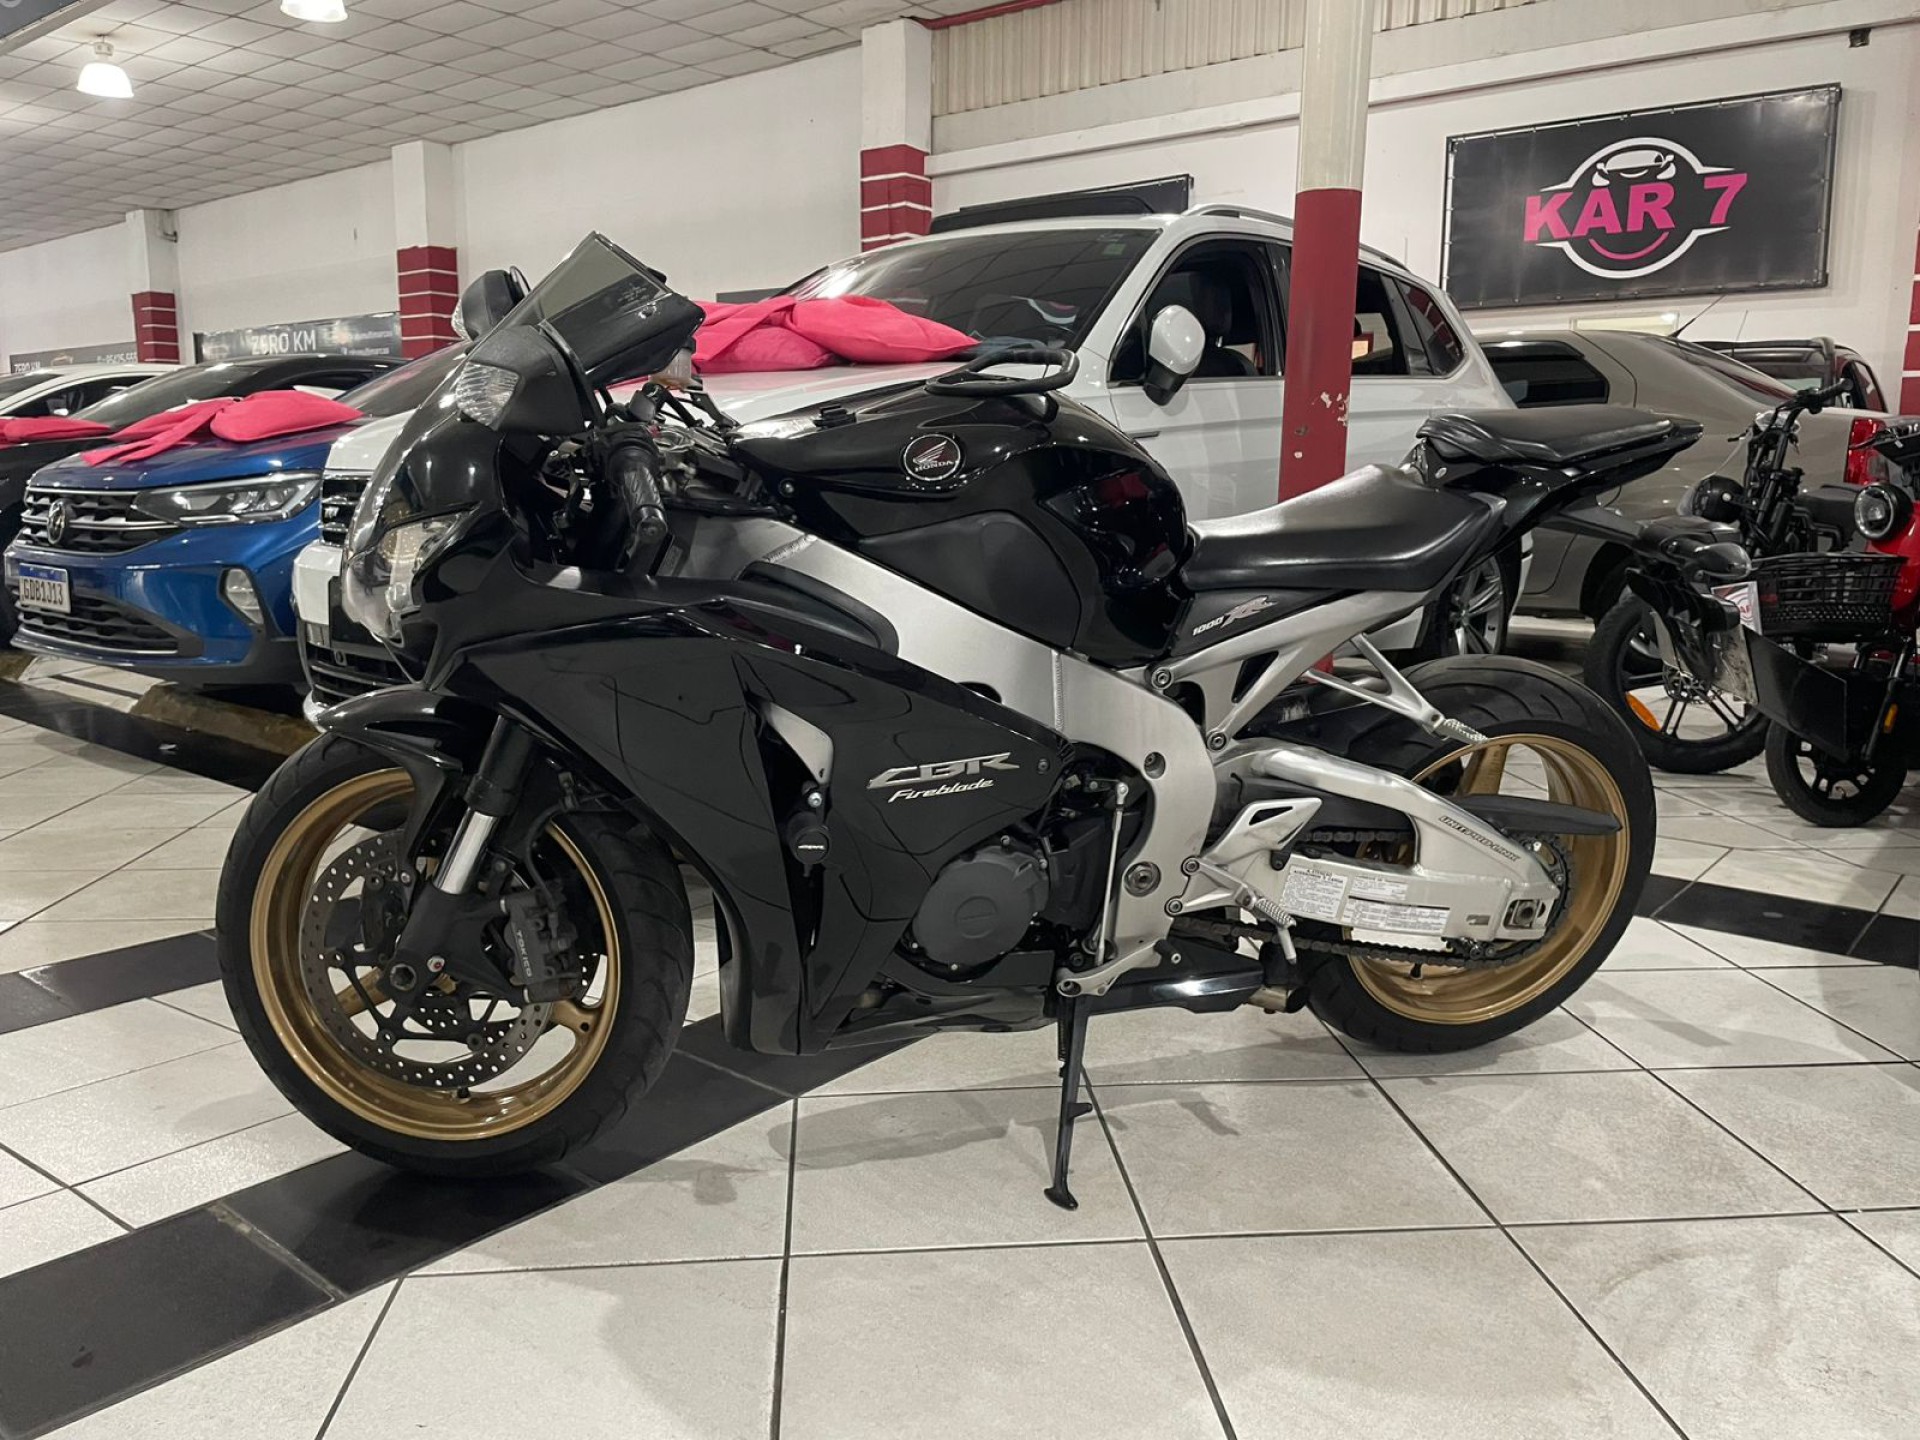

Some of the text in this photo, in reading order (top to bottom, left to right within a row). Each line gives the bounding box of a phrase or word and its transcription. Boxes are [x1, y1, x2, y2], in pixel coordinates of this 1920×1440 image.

[1523, 173, 1748, 242] KAR 7
[251, 329, 317, 355] ZERO KM
[914, 460, 955, 472] HONDA
[1192, 616, 1225, 636] 1000
[866, 752, 1020, 789] CBR
[888, 778, 994, 803] Fireblade
[516, 930, 532, 977] TOKICO
